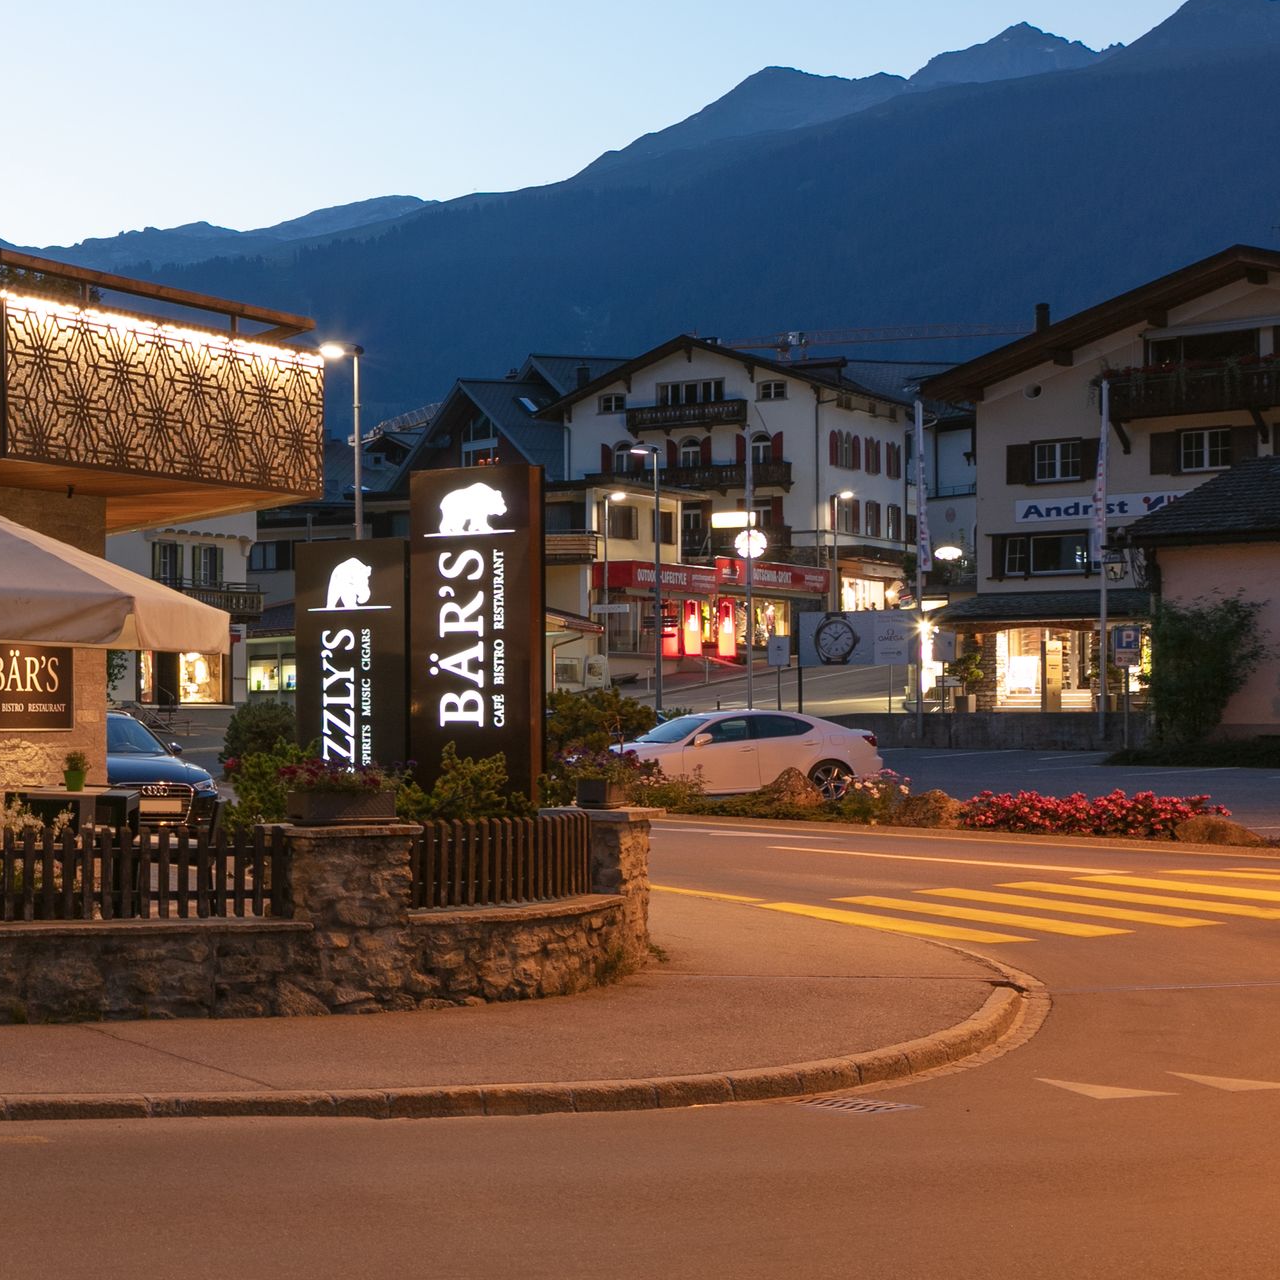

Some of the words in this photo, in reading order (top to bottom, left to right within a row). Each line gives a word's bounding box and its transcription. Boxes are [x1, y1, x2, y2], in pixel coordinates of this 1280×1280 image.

[1022, 500, 1128, 519] Andrst
[494, 549, 505, 630] RESTAURANT
[362, 628, 371, 670] CIGARS
[430, 549, 485, 728] BÄR'S
[494, 639, 505, 685] BISTRO
[2, 703, 24, 712] BISTRO
[28, 703, 66, 712] RESTAURANT
[321, 629, 355, 773] ZZLY'S
[362, 678, 371, 716] MUSIC
[494, 694, 505, 728] CAFÉ
